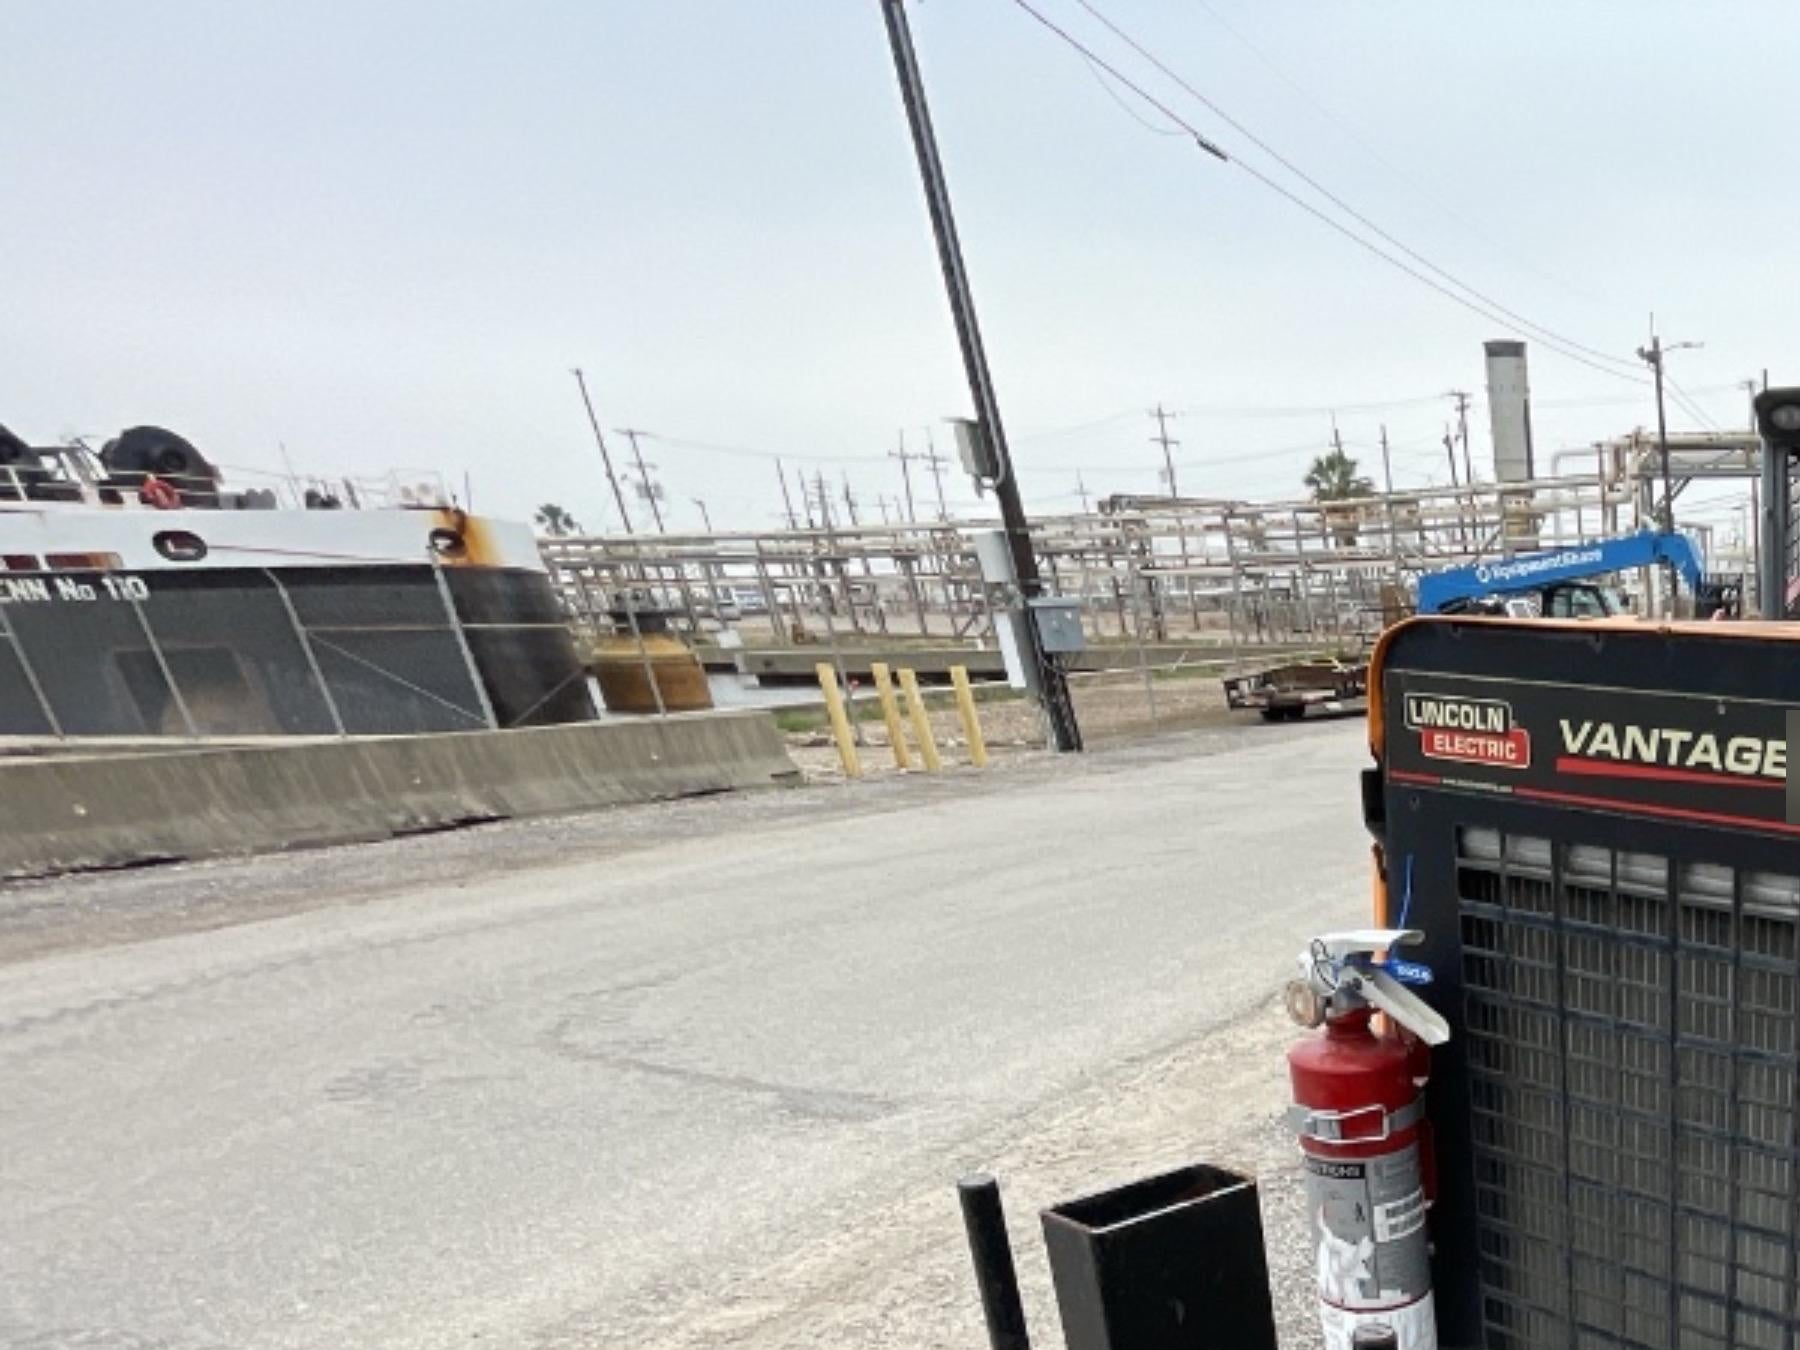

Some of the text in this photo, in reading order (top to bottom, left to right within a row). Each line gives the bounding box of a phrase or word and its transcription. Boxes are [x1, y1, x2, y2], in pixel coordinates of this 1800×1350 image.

[1409, 698, 1505, 733] LINCOLN
[1432, 733, 1517, 761] ELECTRIC
[1559, 718, 1787, 777] VANTAGE
